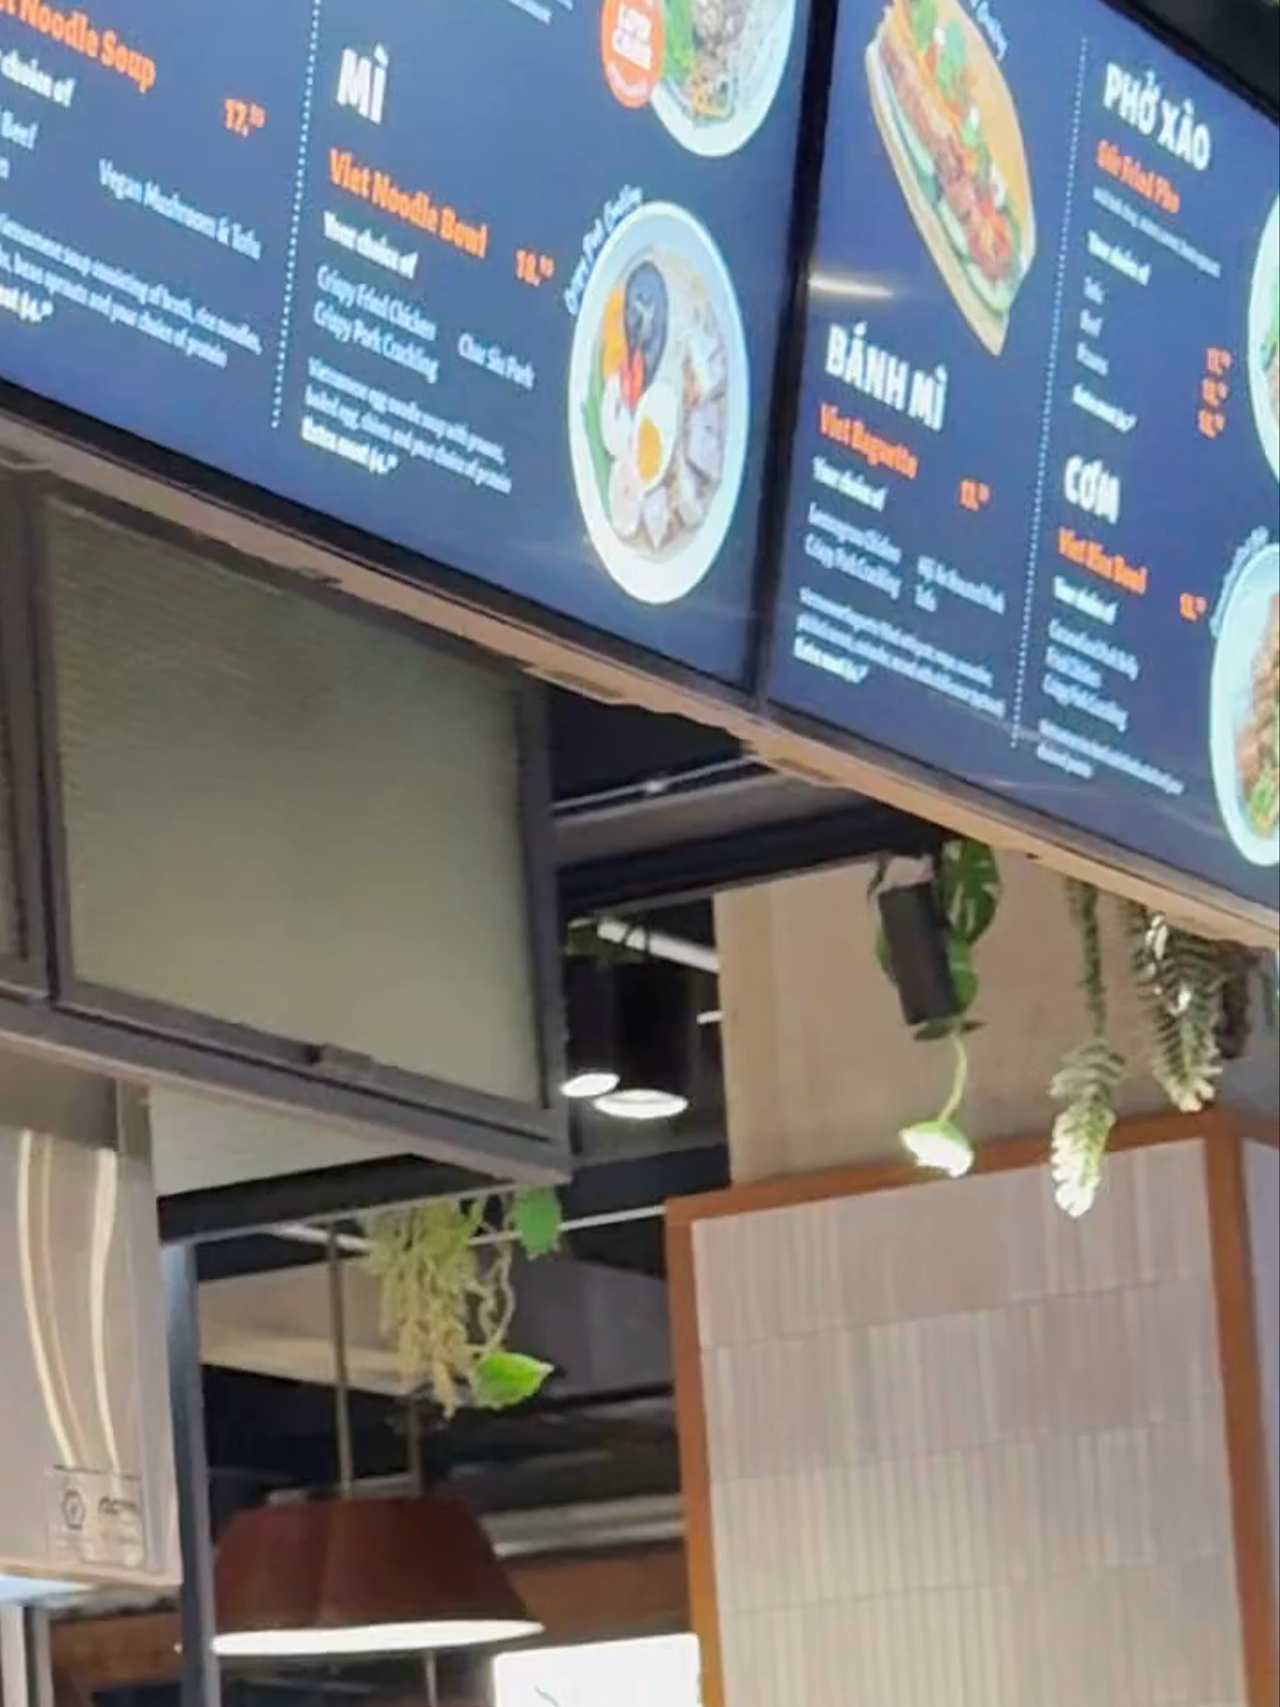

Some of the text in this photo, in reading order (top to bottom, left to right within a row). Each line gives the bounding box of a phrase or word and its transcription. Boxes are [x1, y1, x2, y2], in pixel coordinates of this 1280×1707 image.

[0, 51, 53, 97] choice
[51, 78, 75, 107] of
[99, 30, 156, 92] Soup
[336, 45, 388, 122] MÌ
[0, 110, 37, 149] Beef
[1103, 63, 1210, 170] PHỞ XÀO
[98, 158, 142, 201] Vegan
[143, 181, 216, 237] Mushroom
[231, 222, 260, 260] Tofu
[329, 148, 487, 256] Viet Noodle Bowl
[323, 210, 418, 279] Your choice of
[825, 323, 946, 429] BÁNH MÌ
[1063, 456, 1119, 522] CƠM
